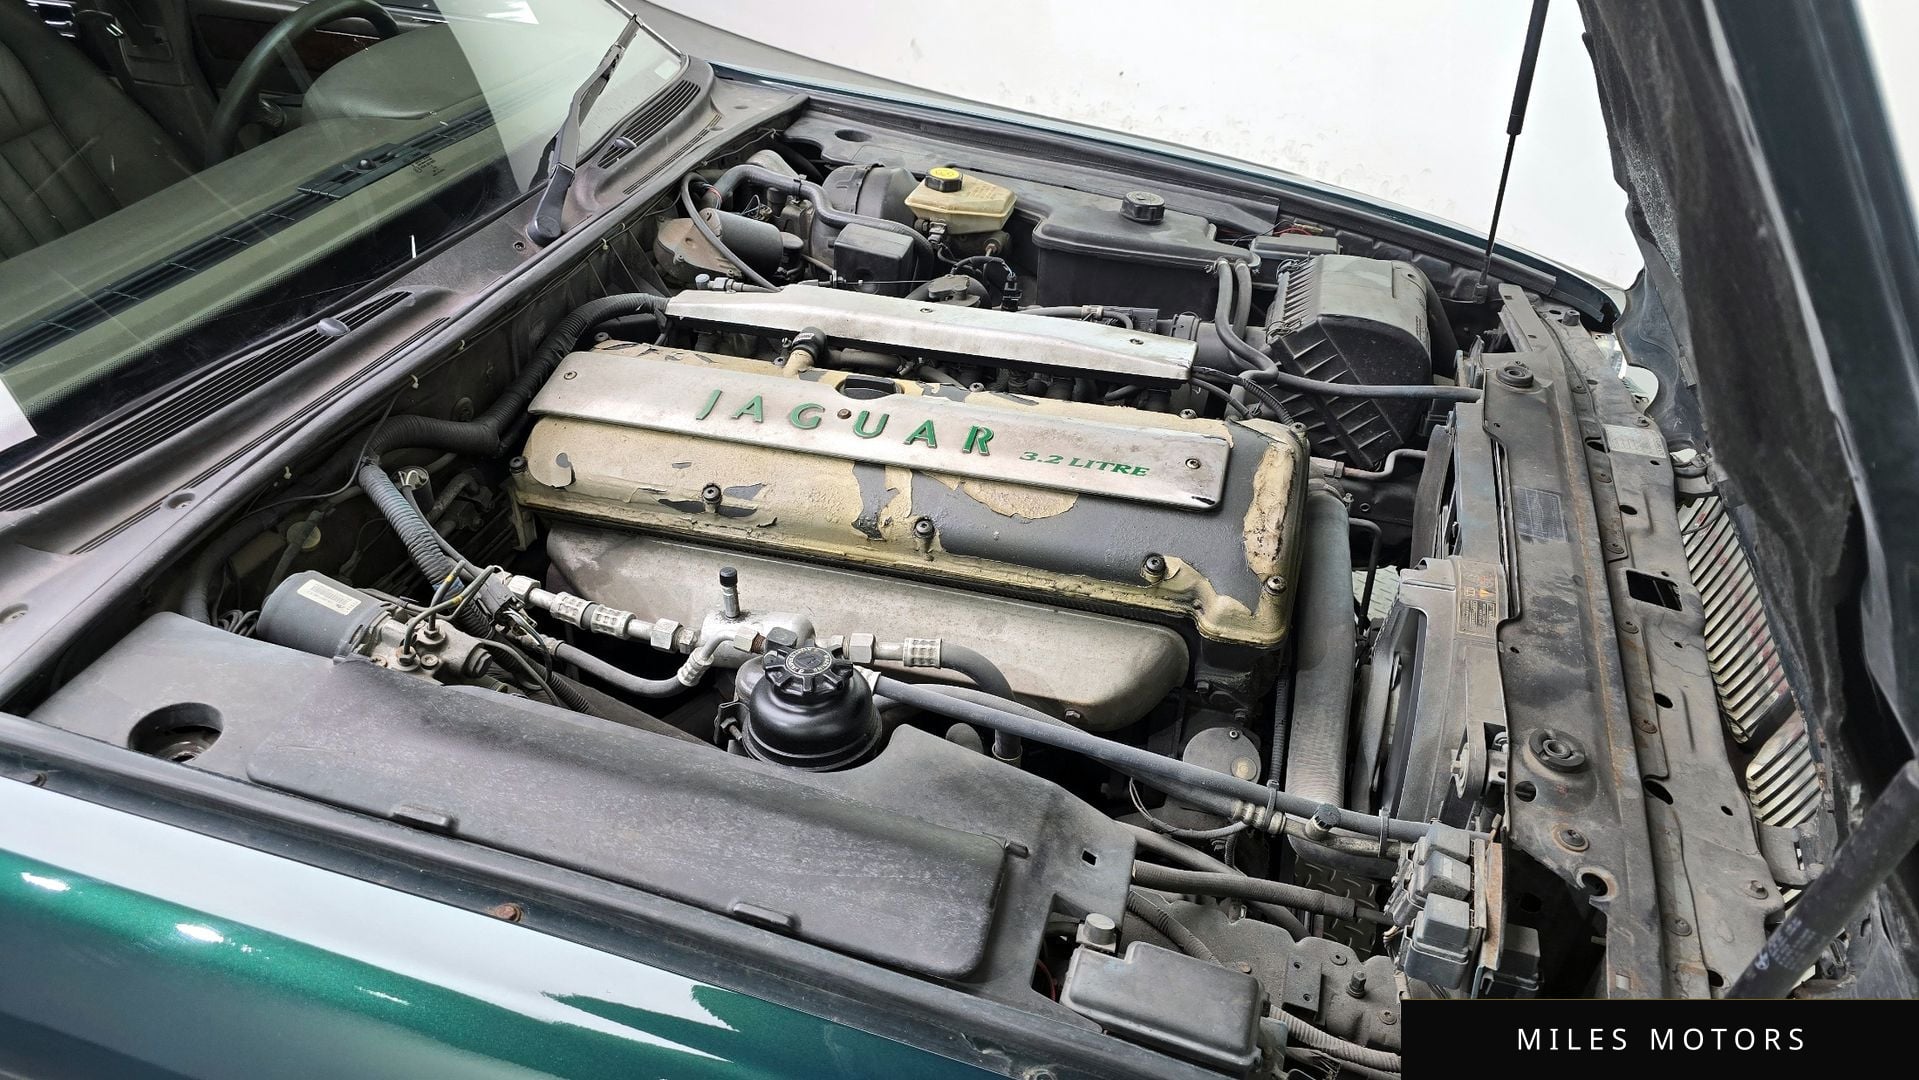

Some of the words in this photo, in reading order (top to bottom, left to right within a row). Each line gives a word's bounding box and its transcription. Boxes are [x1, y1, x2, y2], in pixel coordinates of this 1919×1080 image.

[695, 389, 995, 457] JAGUAR
[1019, 451, 1064, 465] 3.2
[1068, 457, 1150, 477] LITRE
